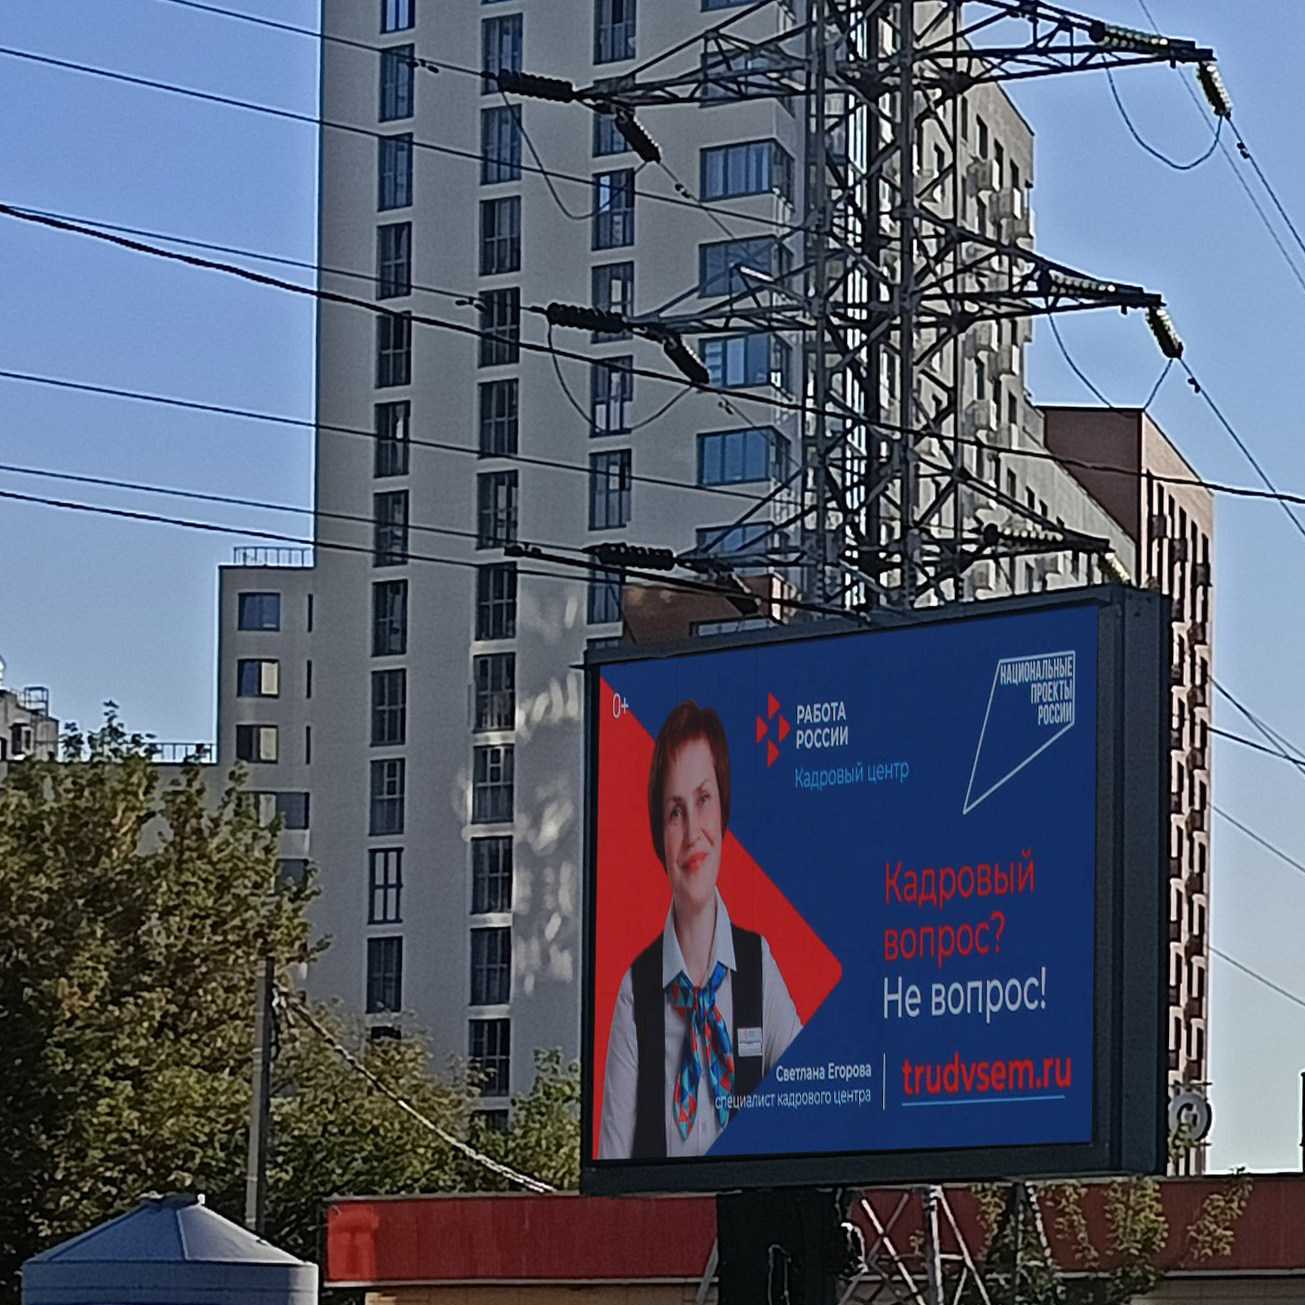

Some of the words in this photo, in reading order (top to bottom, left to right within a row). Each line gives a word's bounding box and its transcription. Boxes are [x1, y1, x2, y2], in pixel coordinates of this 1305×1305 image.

[1000, 656, 1073, 687] НАЦИОНАЛЬНЫЕ
[1030, 679, 1073, 704] ПРОЕКТЫ
[612, 692, 630, 719] 0+
[796, 700, 847, 725] РАБОТА
[1037, 701, 1073, 726] РОССИИ
[796, 725, 849, 750] РОССИИ
[794, 761, 864, 791] Кадровый
[867, 761, 910, 784] центр
[884, 848, 1037, 912] Кадровый
[883, 911, 1007, 969] вопрос?
[883, 975, 922, 1019] Не
[931, 966, 1046, 1025] вопрос!
[775, 1064, 826, 1082] Светлана
[828, 1062, 873, 1081] Егорова
[902, 1050, 1072, 1096] trudvsem.ru
[715, 1094, 776, 1111] специалист
[777, 1091, 832, 1110] кадрового
[834, 1087, 872, 1106] центра
